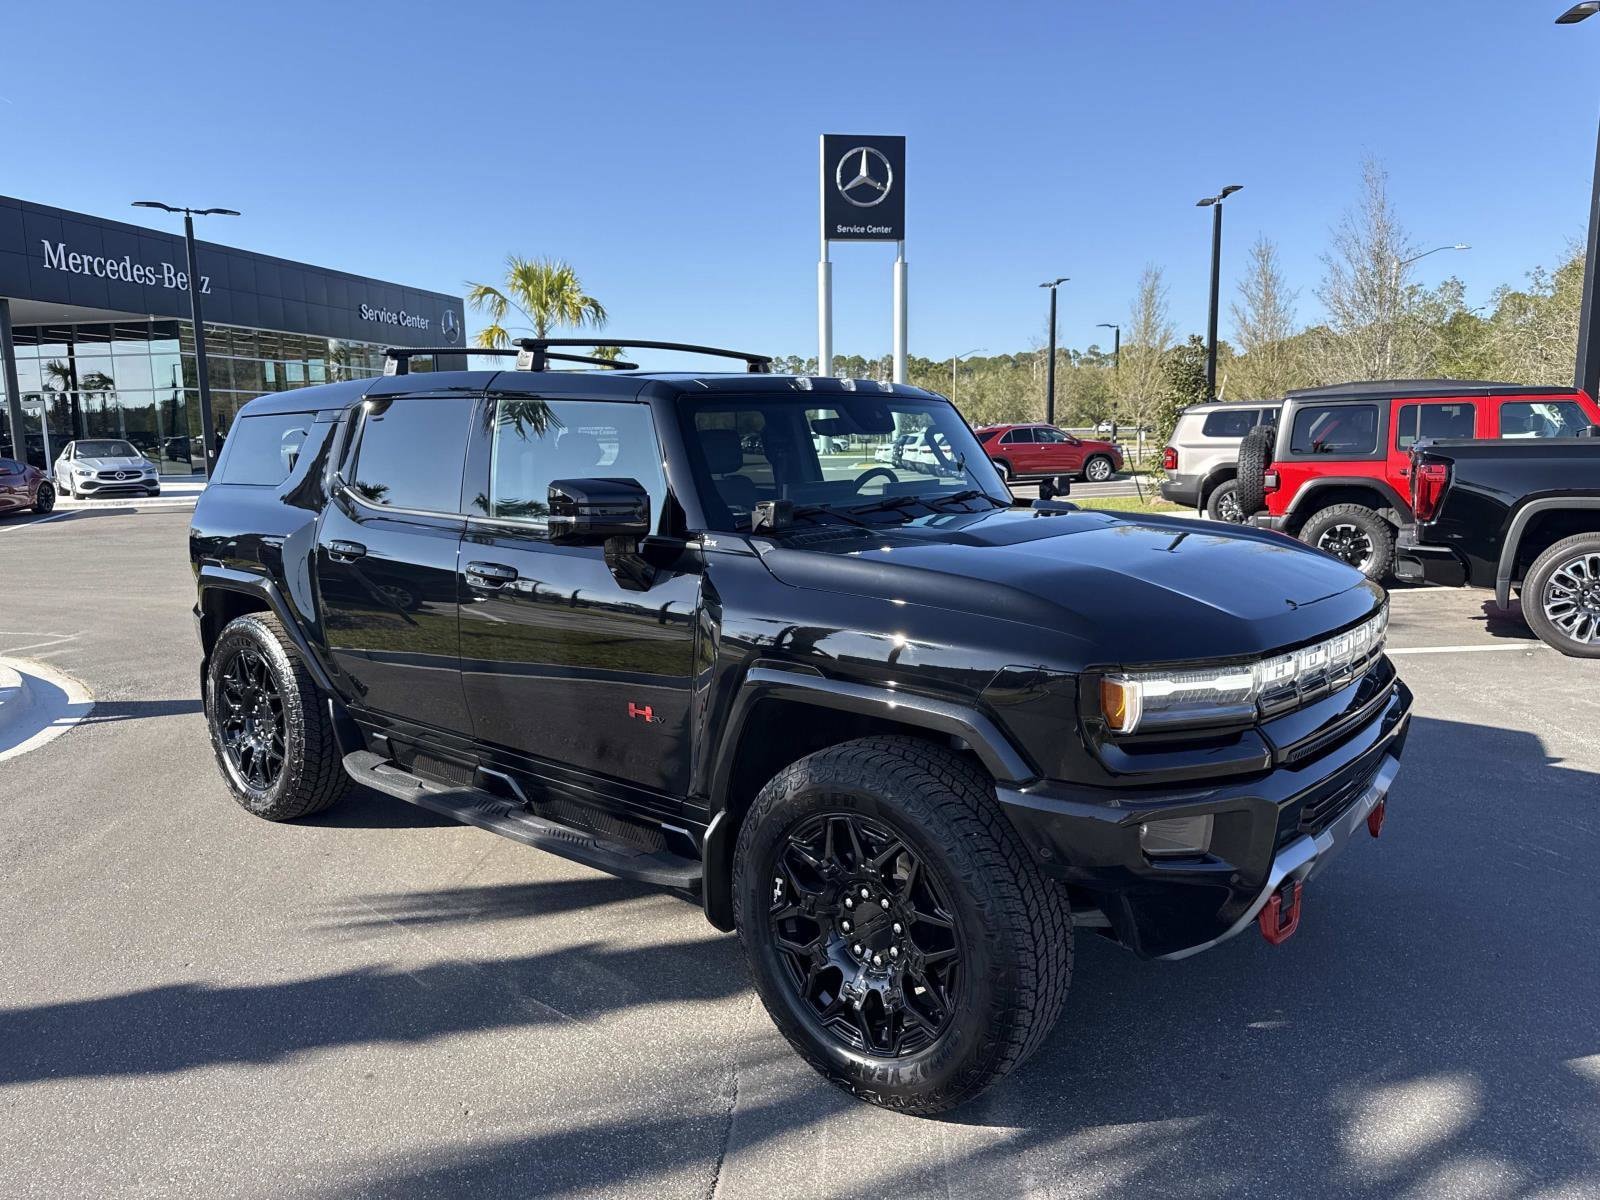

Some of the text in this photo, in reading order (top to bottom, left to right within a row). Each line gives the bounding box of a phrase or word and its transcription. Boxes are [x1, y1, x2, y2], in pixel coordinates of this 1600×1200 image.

[836, 224, 893, 234] Service Center
[41, 239, 211, 294] Mercedes-Bez
[360, 303, 430, 330] Service Center
